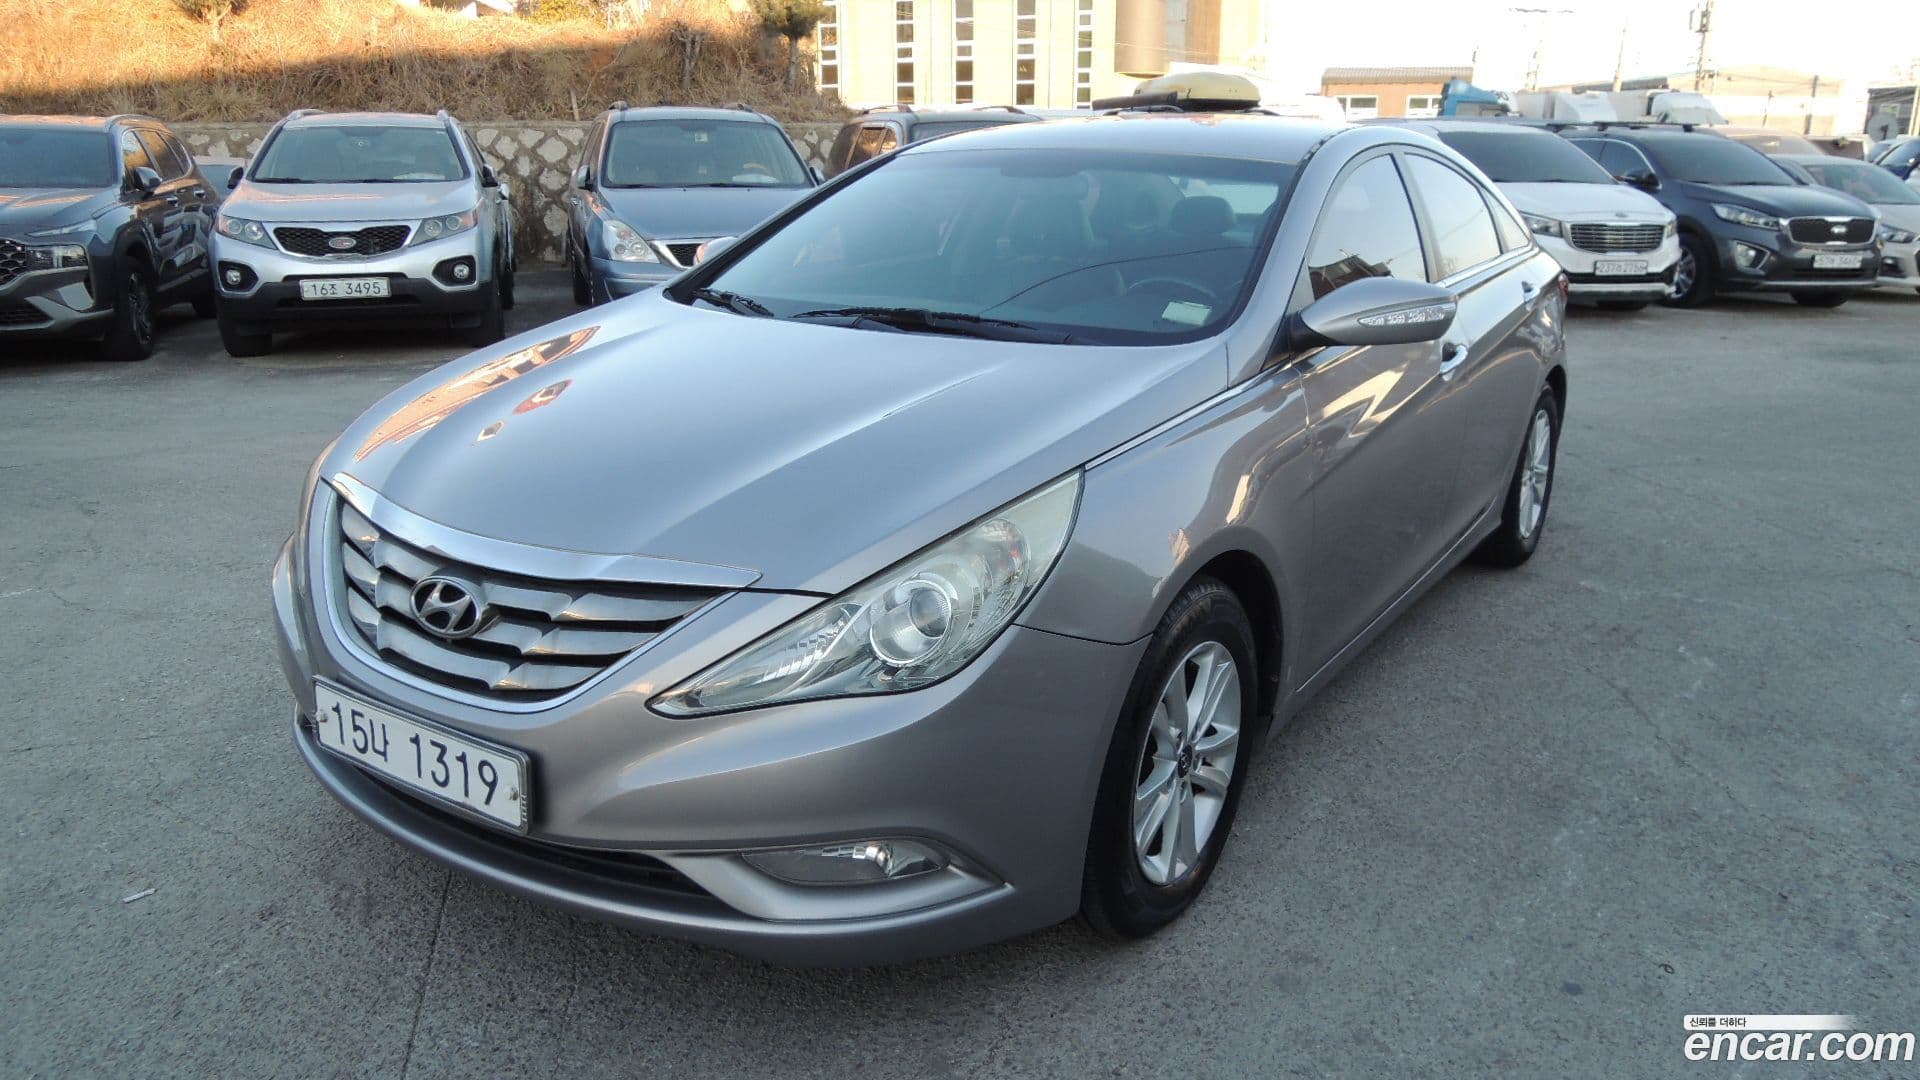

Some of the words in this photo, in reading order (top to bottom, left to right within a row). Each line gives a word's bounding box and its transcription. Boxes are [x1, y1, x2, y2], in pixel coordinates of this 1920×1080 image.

[311, 283, 338, 296] 16조
[344, 282, 381, 295] 3495
[331, 701, 389, 762] 15나
[409, 732, 499, 806] 1319
